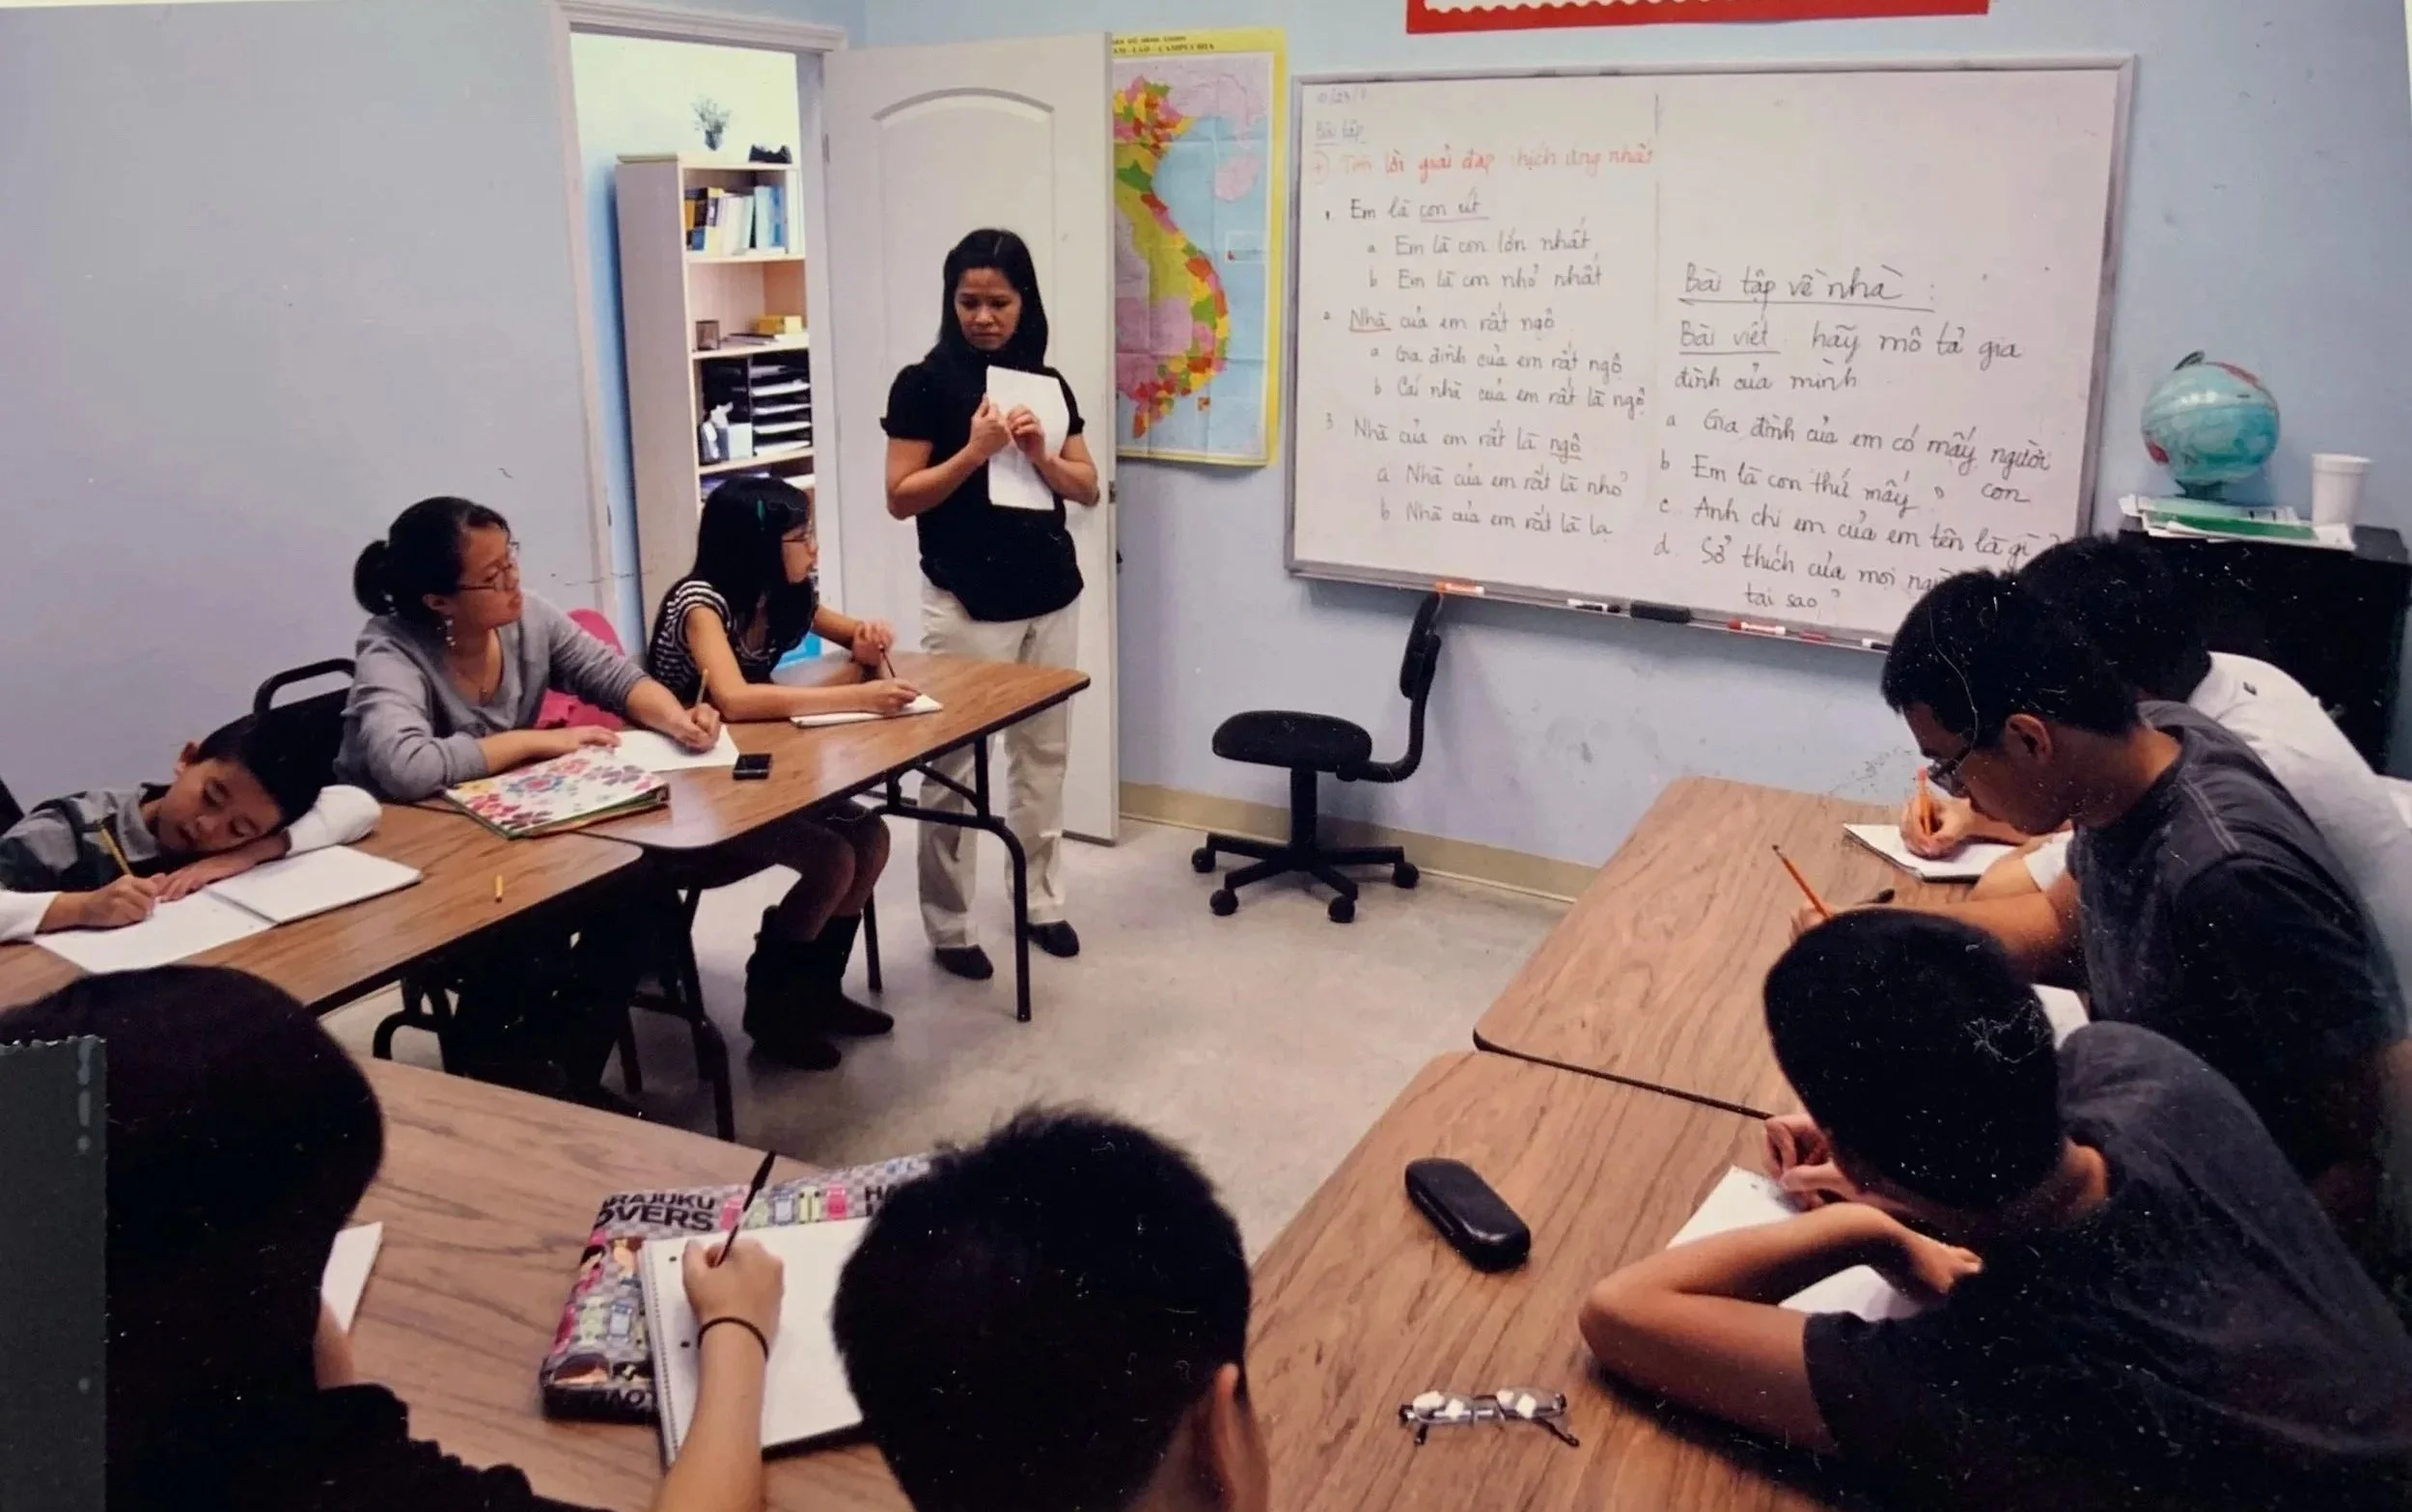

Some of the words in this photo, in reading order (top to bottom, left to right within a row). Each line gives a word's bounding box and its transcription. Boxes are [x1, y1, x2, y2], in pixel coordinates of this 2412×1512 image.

[1350, 198, 1377, 220] Em
[1388, 195, 1410, 219] là
[1419, 203, 1448, 218] con
[1395, 234, 1425, 257] Em
[1432, 234, 1453, 255] là
[1458, 240, 1487, 255] con
[1539, 215, 1592, 252] nhất
[1370, 265, 1378, 289] b
[1398, 268, 1426, 290] Em
[1436, 268, 1456, 289] là
[1462, 273, 1490, 289] con
[1501, 262, 1539, 289] nhỏ
[1553, 251, 1603, 287] nhất
[1738, 265, 1778, 320] tập
[1788, 267, 1828, 297] về
[1827, 262, 1905, 300] nhà
[1349, 307, 1388, 329] Nhà
[1439, 316, 1468, 331] em
[1480, 300, 1510, 333] rất
[1515, 354, 1542, 369] em
[1551, 339, 1579, 371] rất
[1680, 319, 1716, 347] Bài
[1811, 319, 1859, 366] hãy
[1878, 325, 1923, 353] mô
[1935, 320, 1966, 357] tả
[1978, 339, 2024, 372] gia
[1373, 374, 1383, 397] b
[1430, 377, 1463, 400] nhà
[1515, 388, 1539, 403] em
[1548, 375, 1576, 406] rất
[1587, 385, 1606, 407] là
[1675, 364, 1721, 390] đình
[1733, 362, 1773, 392] của
[1788, 357, 1858, 392] mình
[1353, 416, 1391, 443] Nhà
[1443, 432, 1468, 447] em
[1479, 418, 1508, 448] rất
[1516, 426, 1542, 451] là
[1666, 414, 1677, 427] a
[1703, 408, 1739, 434] Gia
[1750, 413, 1795, 442] đình
[1806, 414, 1839, 444] của
[1849, 433, 1883, 450] em
[1891, 423, 1921, 453] có
[1927, 426, 1978, 477] mấy
[1989, 438, 2052, 481] người
[1375, 466, 1391, 484] a
[1405, 461, 1445, 486] Nhà
[1490, 475, 1517, 490] em
[1523, 462, 1551, 492] rất
[1559, 471, 1580, 492] là
[1586, 469, 1629, 498] nhỏ
[1659, 447, 1671, 471] b
[1690, 453, 1728, 483] Em
[1736, 460, 1763, 486] là
[1766, 473, 1803, 492] con
[1808, 466, 1851, 500] thứ
[1863, 470, 1920, 520] mấy
[1980, 481, 2032, 504] con
[1379, 495, 1391, 522] b
[1405, 499, 1444, 523] Nhà
[1489, 513, 1516, 530] em
[1524, 503, 1552, 533] rất
[1560, 511, 1583, 534] là
[1693, 495, 1740, 523] Anh
[1792, 516, 1827, 536] em
[1836, 509, 1878, 542] của
[1886, 528, 1922, 549] em
[1930, 522, 1965, 553] tên
[1974, 526, 2010, 556] là
[1807, 549, 1847, 582] của
[1785, 592, 1818, 609] sao
